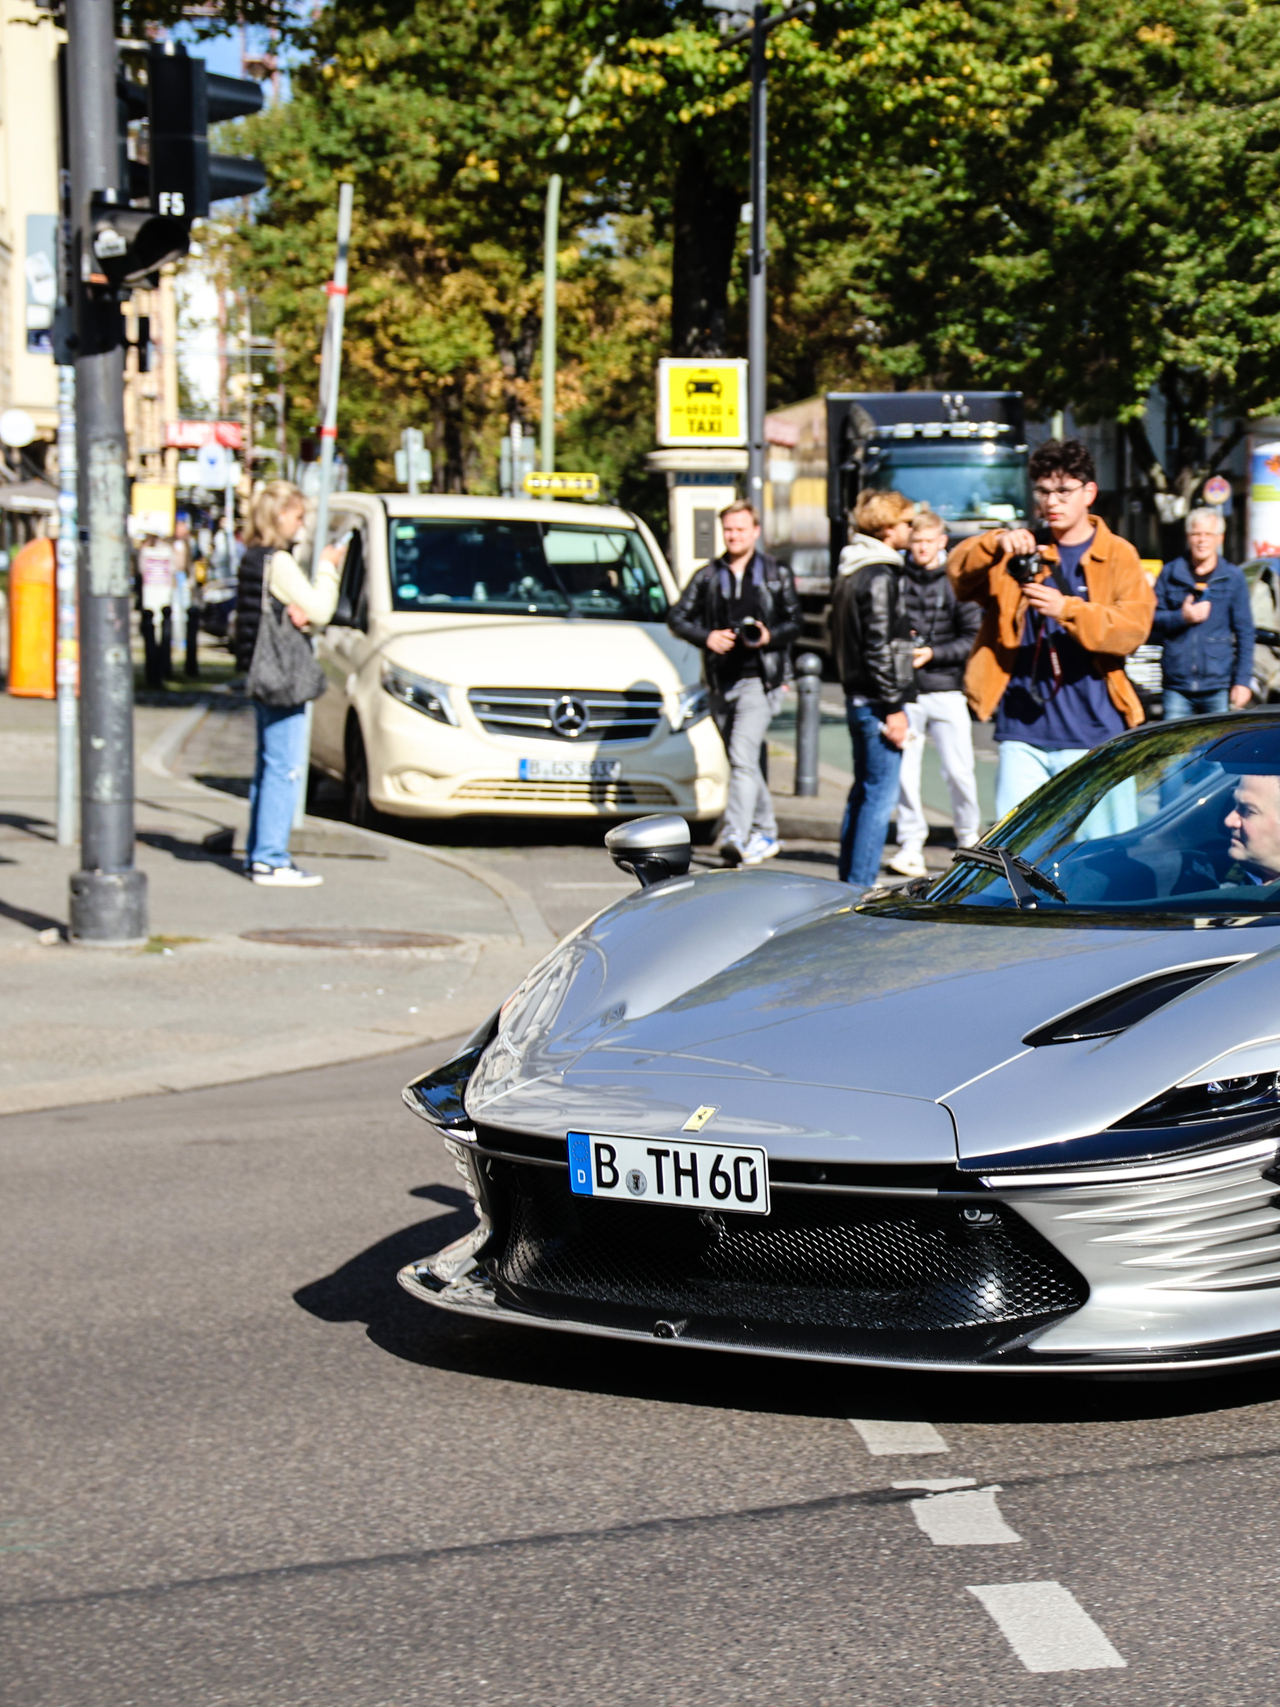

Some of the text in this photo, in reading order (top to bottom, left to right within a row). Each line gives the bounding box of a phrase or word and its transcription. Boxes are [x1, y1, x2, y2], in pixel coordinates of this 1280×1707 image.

[158, 191, 186, 217] F5
[688, 419, 722, 433] TAXI
[577, 1143, 758, 1203] D B TH 60
